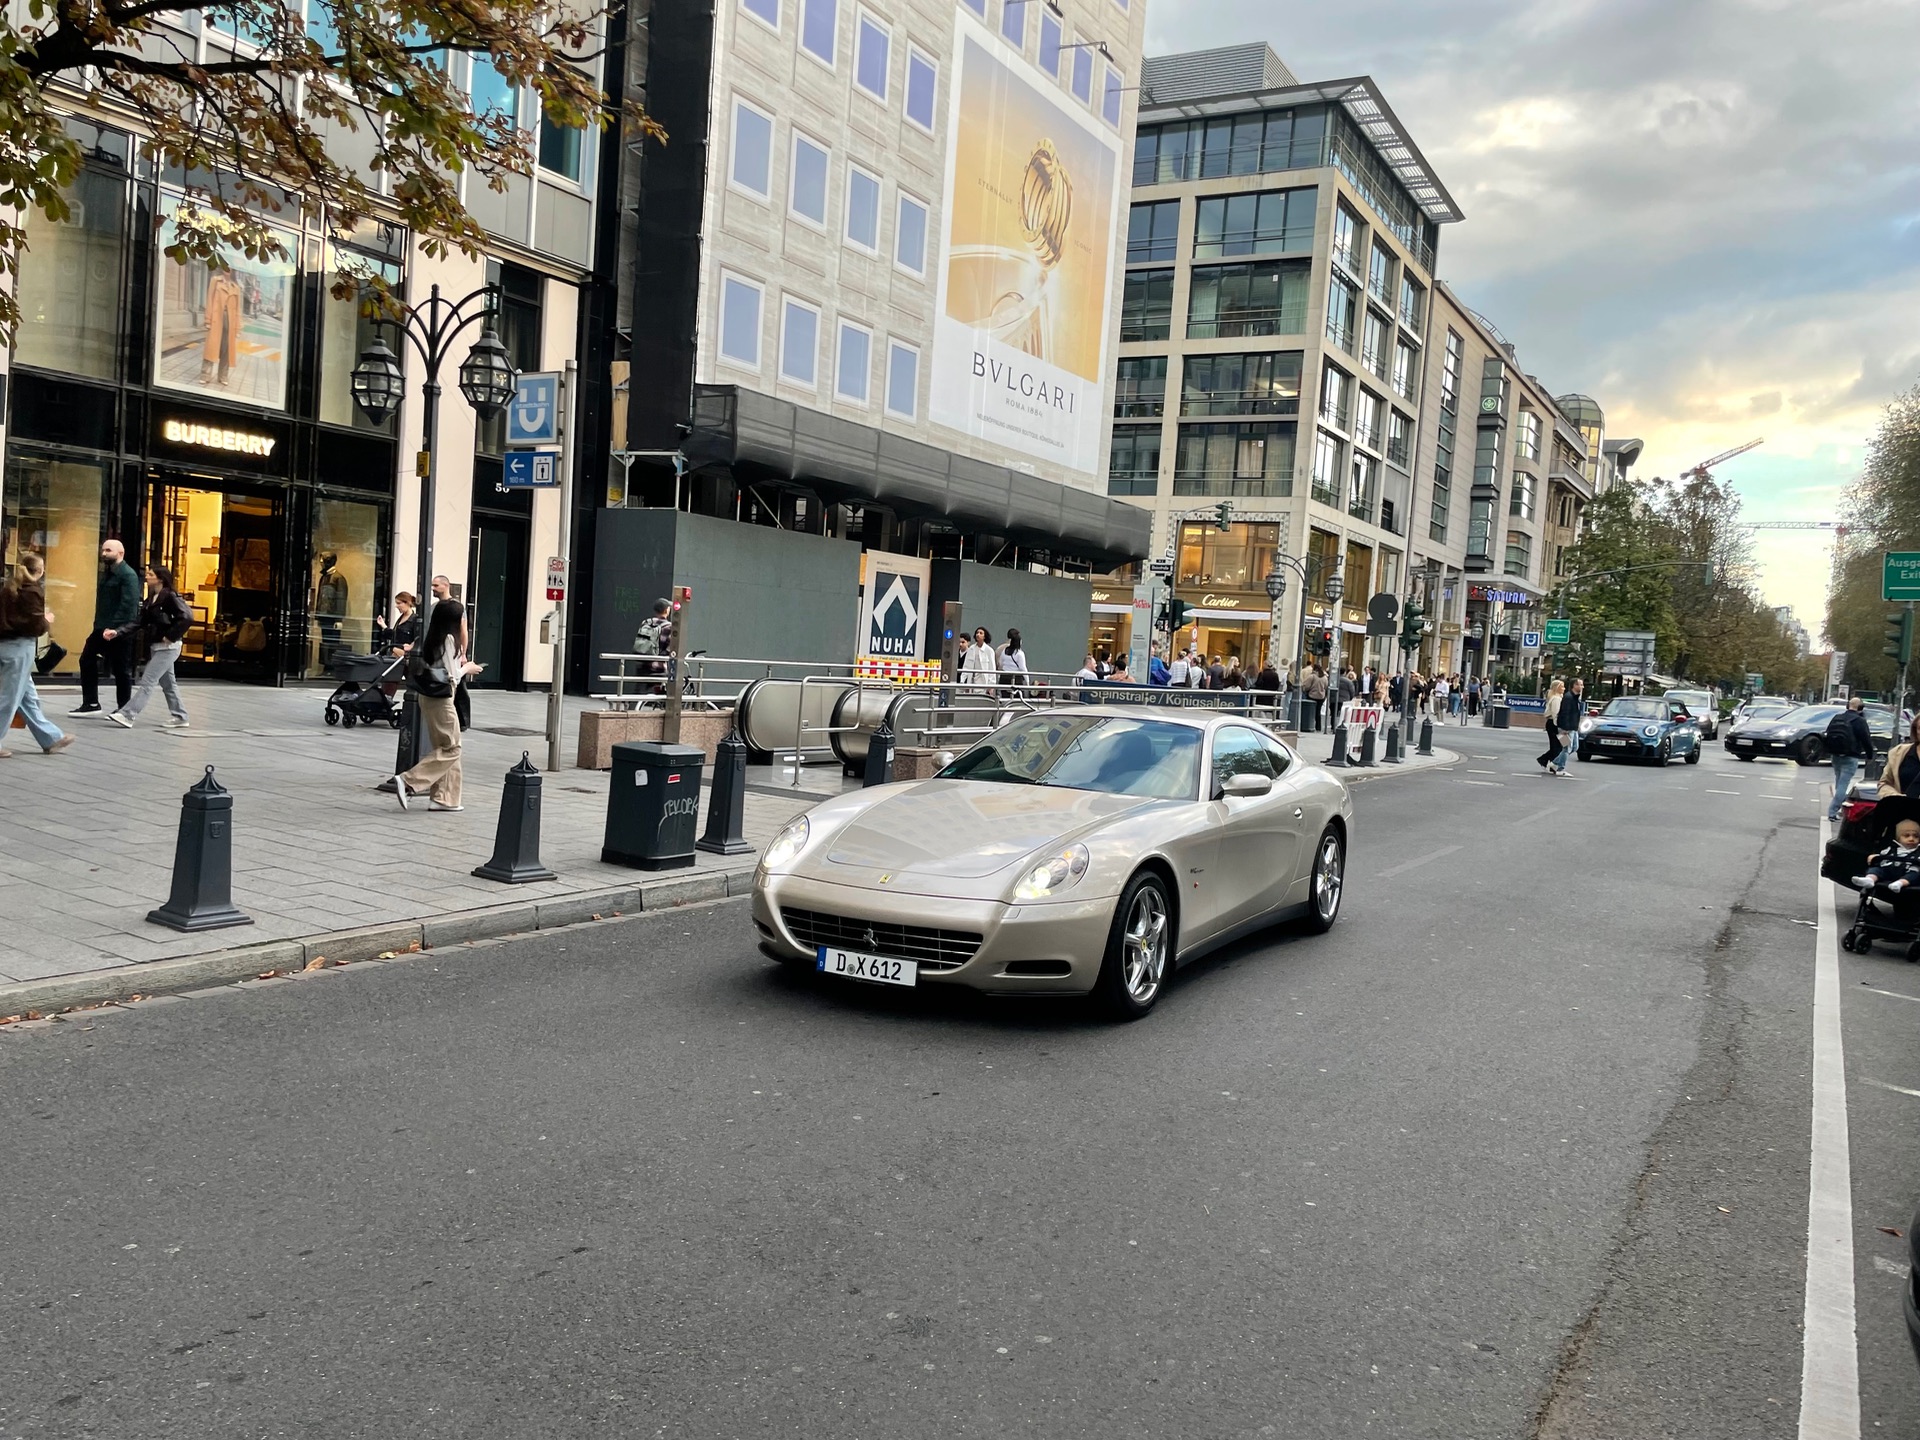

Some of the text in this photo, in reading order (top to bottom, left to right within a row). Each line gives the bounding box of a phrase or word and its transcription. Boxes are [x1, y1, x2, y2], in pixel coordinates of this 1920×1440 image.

[978, 178, 1012, 205] ETERNALLY
[1074, 240, 1092, 254] ICONIC
[972, 351, 1074, 413] BVLGARI
[1006, 398, 1043, 418] ROMA 1884
[165, 420, 276, 456] BURBERRY
[1202, 594, 1240, 607] Cartier
[1487, 589, 1527, 604] SATURN
[871, 636, 914, 654] NUHA
[1090, 690, 1157, 704] Steinstraße
[870, 959, 902, 981] 612
